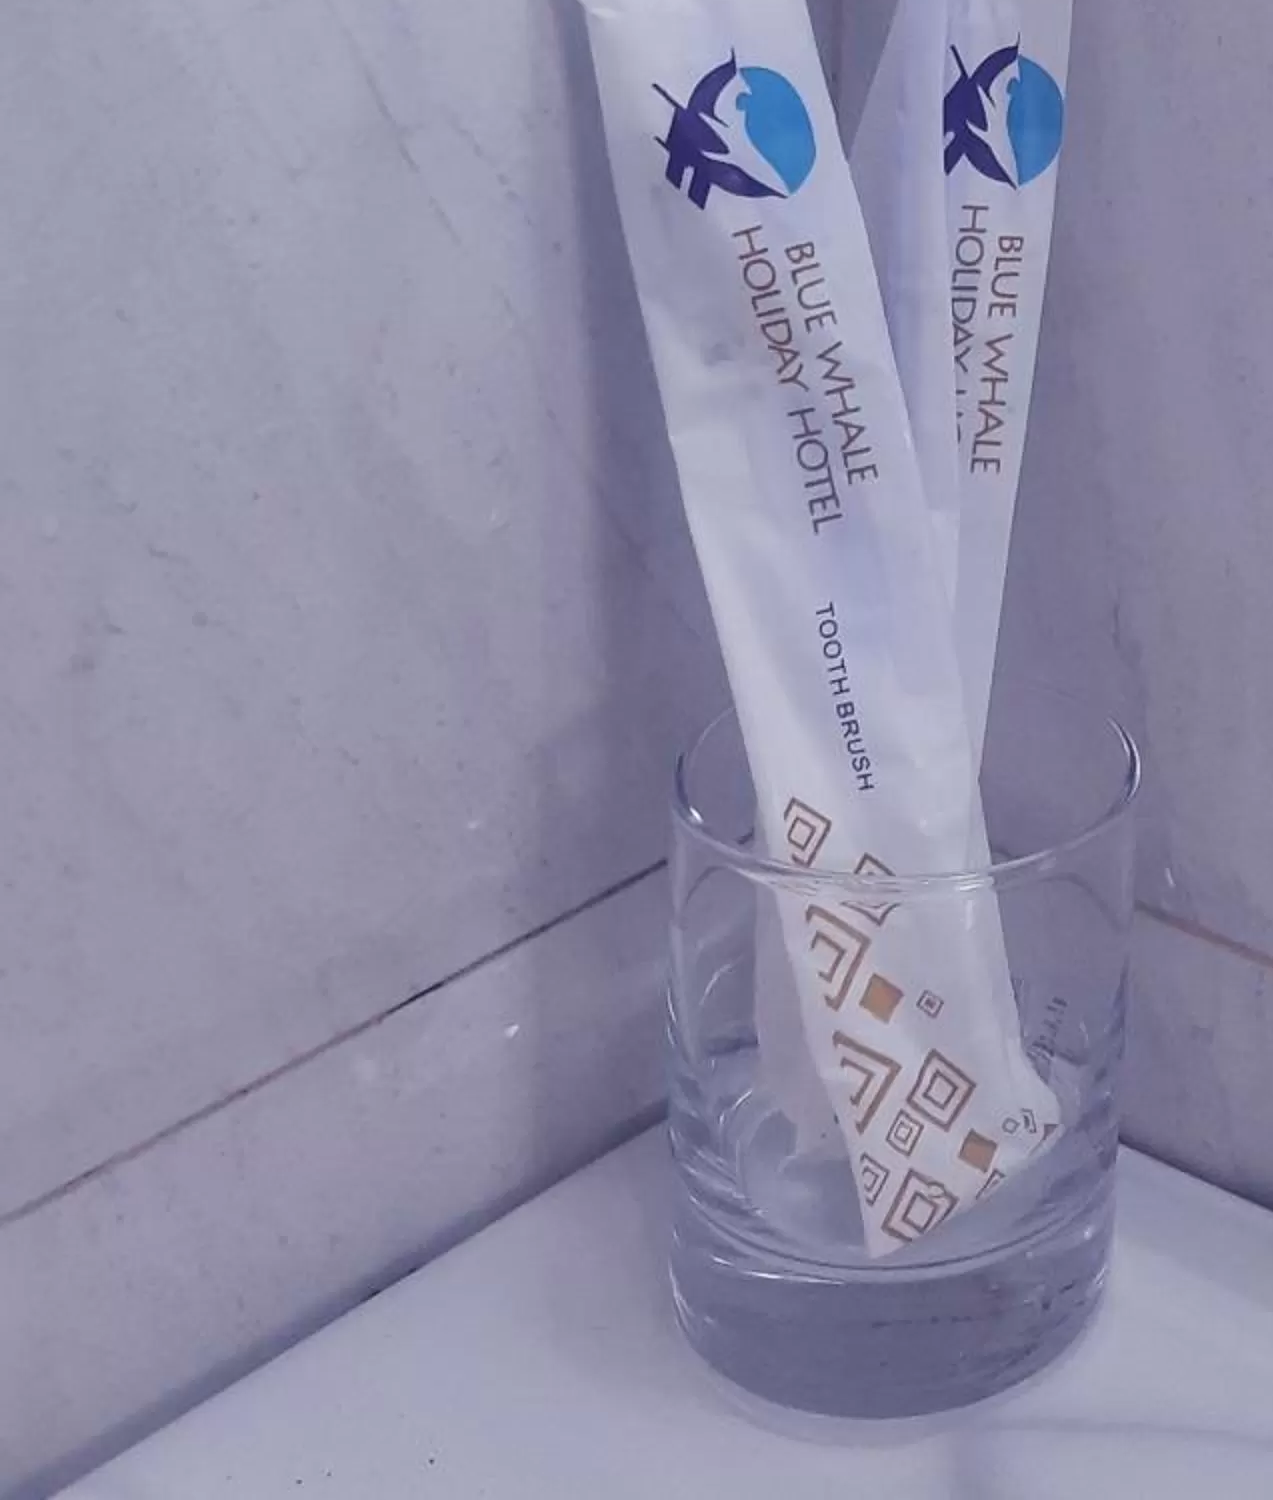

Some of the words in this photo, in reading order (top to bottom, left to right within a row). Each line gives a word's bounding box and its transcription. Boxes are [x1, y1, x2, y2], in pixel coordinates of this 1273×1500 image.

[784, 241, 838, 334] BLUE
[815, 342, 879, 485] WHALE
[950, 204, 990, 374] HOLIDAY
[987, 235, 1024, 319] BLUE
[732, 224, 809, 392] HOLIDAY
[787, 407, 843, 535] HOTEL
[970, 332, 1014, 474] WHALE
[815, 601, 851, 697] TOOTH
[836, 700, 875, 792] BRUSH
